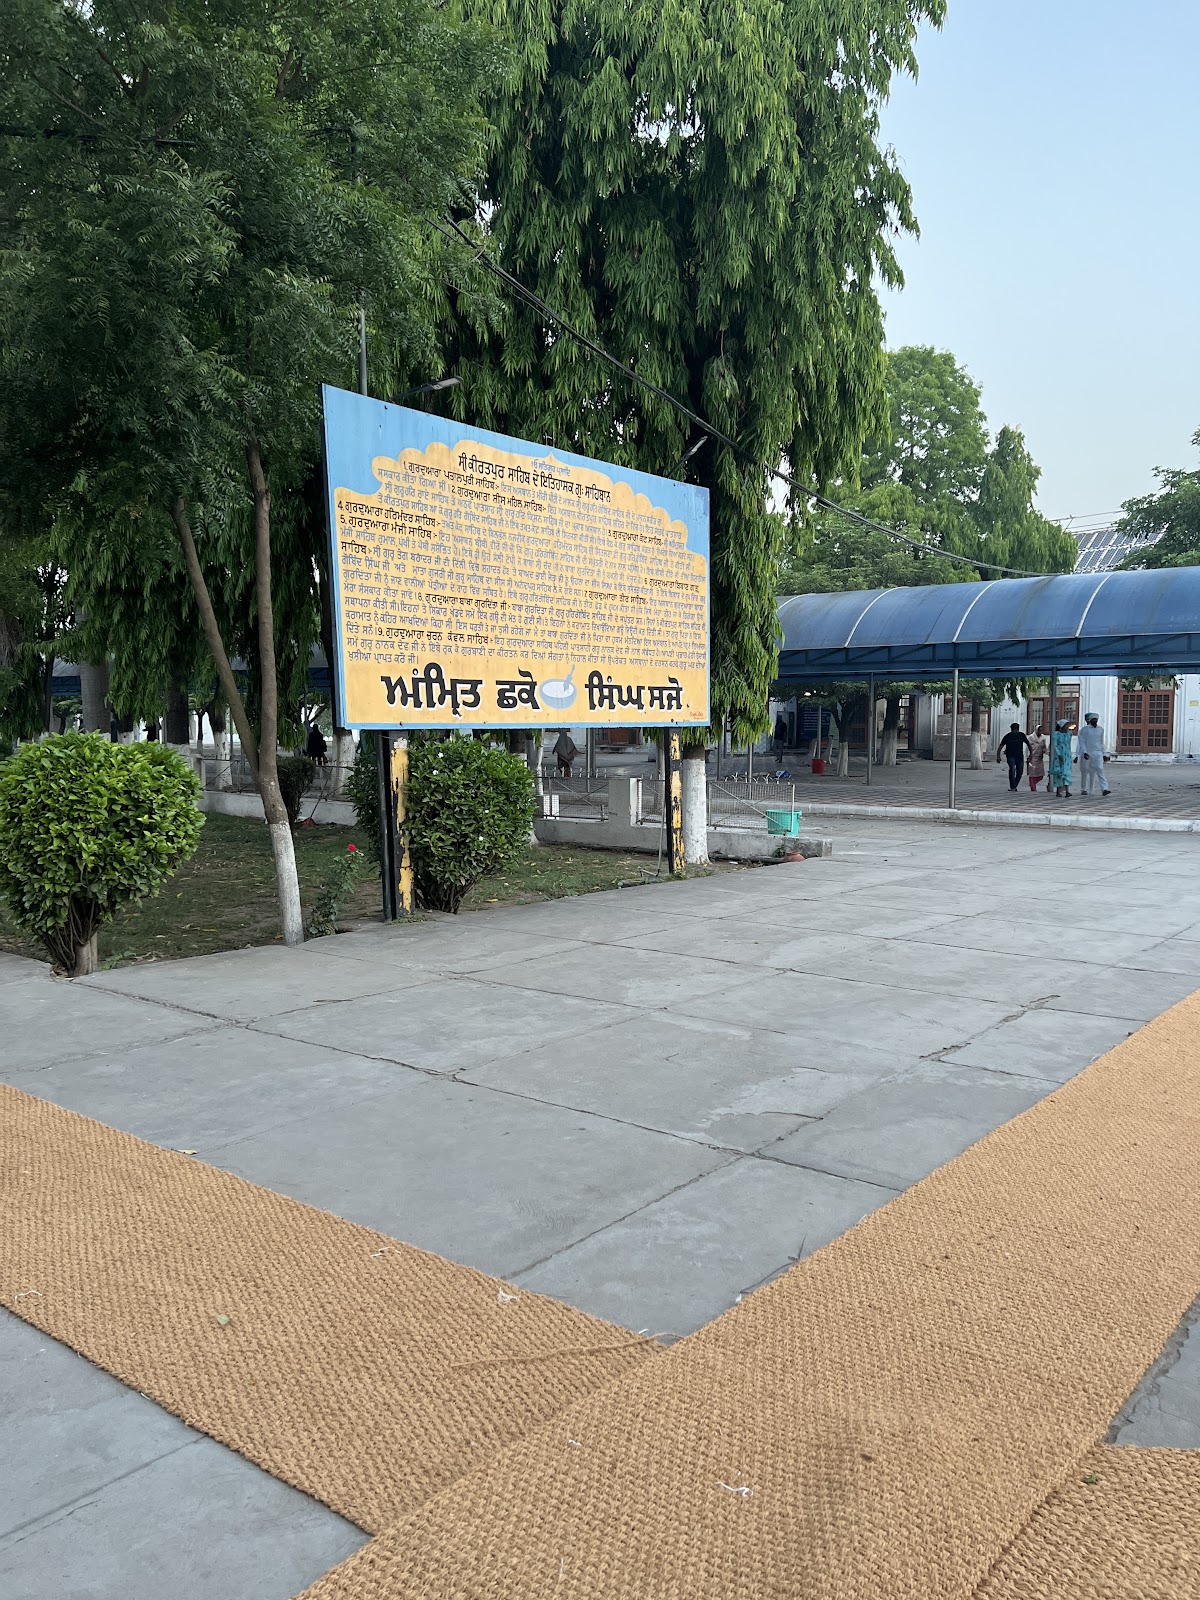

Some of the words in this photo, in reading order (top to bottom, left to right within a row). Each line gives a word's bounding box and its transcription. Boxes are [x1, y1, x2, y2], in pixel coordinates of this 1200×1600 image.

[409, 462, 441, 477] ਗੁਰਦੁਆਰਾ
[458, 452, 467, 472] ਸ੍ਰੀ
[468, 455, 505, 480] ਕੀਰਤਪੁਰ
[508, 466, 530, 484] ਸਾਹਿਬ
[532, 470, 539, 487] ਦੇ
[540, 471, 574, 494] ਇਤਿਹਾਸਕ
[585, 484, 610, 502] ਸਾਹਿਬਾਨ
[458, 486, 490, 502] ਗੁਰਦੁਆਰਾ
[345, 502, 383, 516] ਗੁਰਦੁਆਰਾ
[385, 507, 413, 522] ਹਰਿਮੰਦਰ
[349, 516, 389, 531] ਗੁਰਦੁਆਰਾ
[408, 526, 432, 538] ਸਾਹਿਬ
[356, 529, 376, 542] ਸਾਹਿਬ
[341, 540, 367, 554] ਸਾਹਿਬ
[426, 593, 458, 605] ਗੁਰਦੁਆਰਾ
[459, 597, 473, 606] ਬਾਬਾ
[386, 627, 424, 639] ਗੁਰਦੁਆਰਾ
[426, 631, 442, 640] ਚਰਨ
[467, 633, 488, 644] ਸਾਹਿਬ
[375, 640, 395, 649] ਨਾਨਕ
[411, 639, 419, 651] ਜੀ
[382, 662, 482, 715] ਅੰਮ੍ਰਿਤ
[496, 670, 539, 709] ਛਕੋ
[585, 671, 645, 710] ਸਿੰਘ
[648, 677, 682, 710] ਸਜੋ
